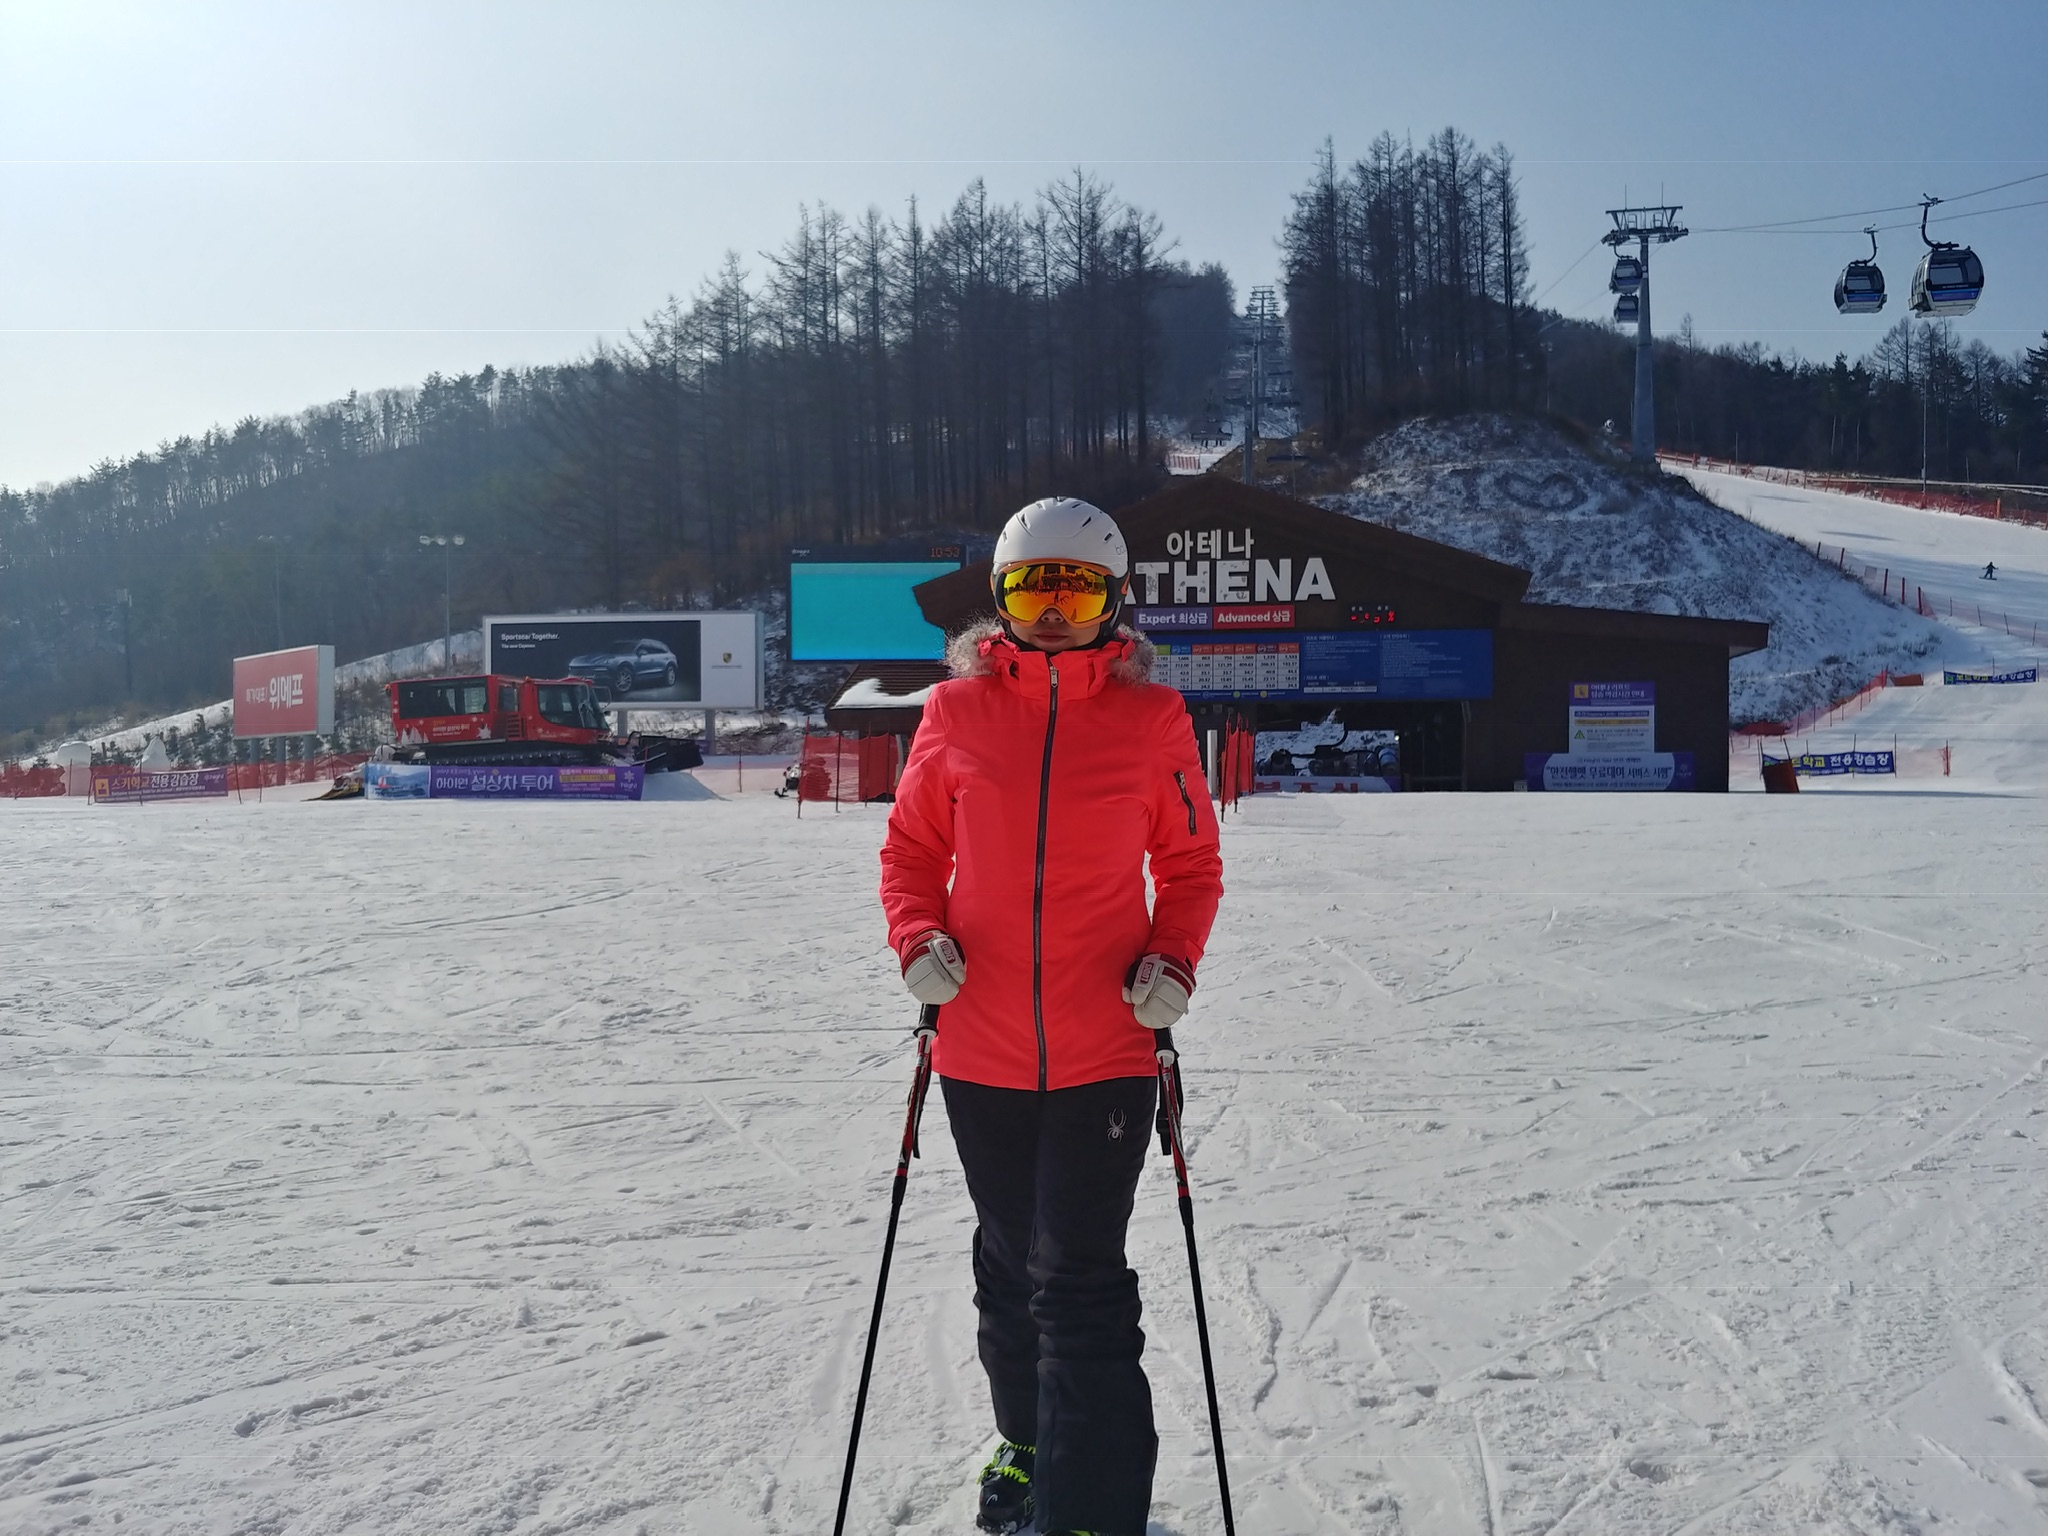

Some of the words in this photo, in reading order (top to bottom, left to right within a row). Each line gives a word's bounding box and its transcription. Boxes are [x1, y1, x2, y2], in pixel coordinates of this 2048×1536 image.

[1166, 528, 1254, 560] 아테나
[1125, 557, 1336, 605] THENA
[1138, 613, 1176, 626] Expert
[1178, 612, 1208, 625] 최상급
[1217, 612, 1271, 623] Advanced
[1272, 610, 1291, 623] 상급
[269, 673, 304, 711] 위메프
[1830, 754, 1889, 767] 전용강습장
[111, 776, 150, 790] 스키학교
[150, 772, 199, 788] 전용강습장
[436, 777, 468, 790] 하이원
[471, 775, 518, 792] 설상차
[520, 774, 554, 792] 투어
